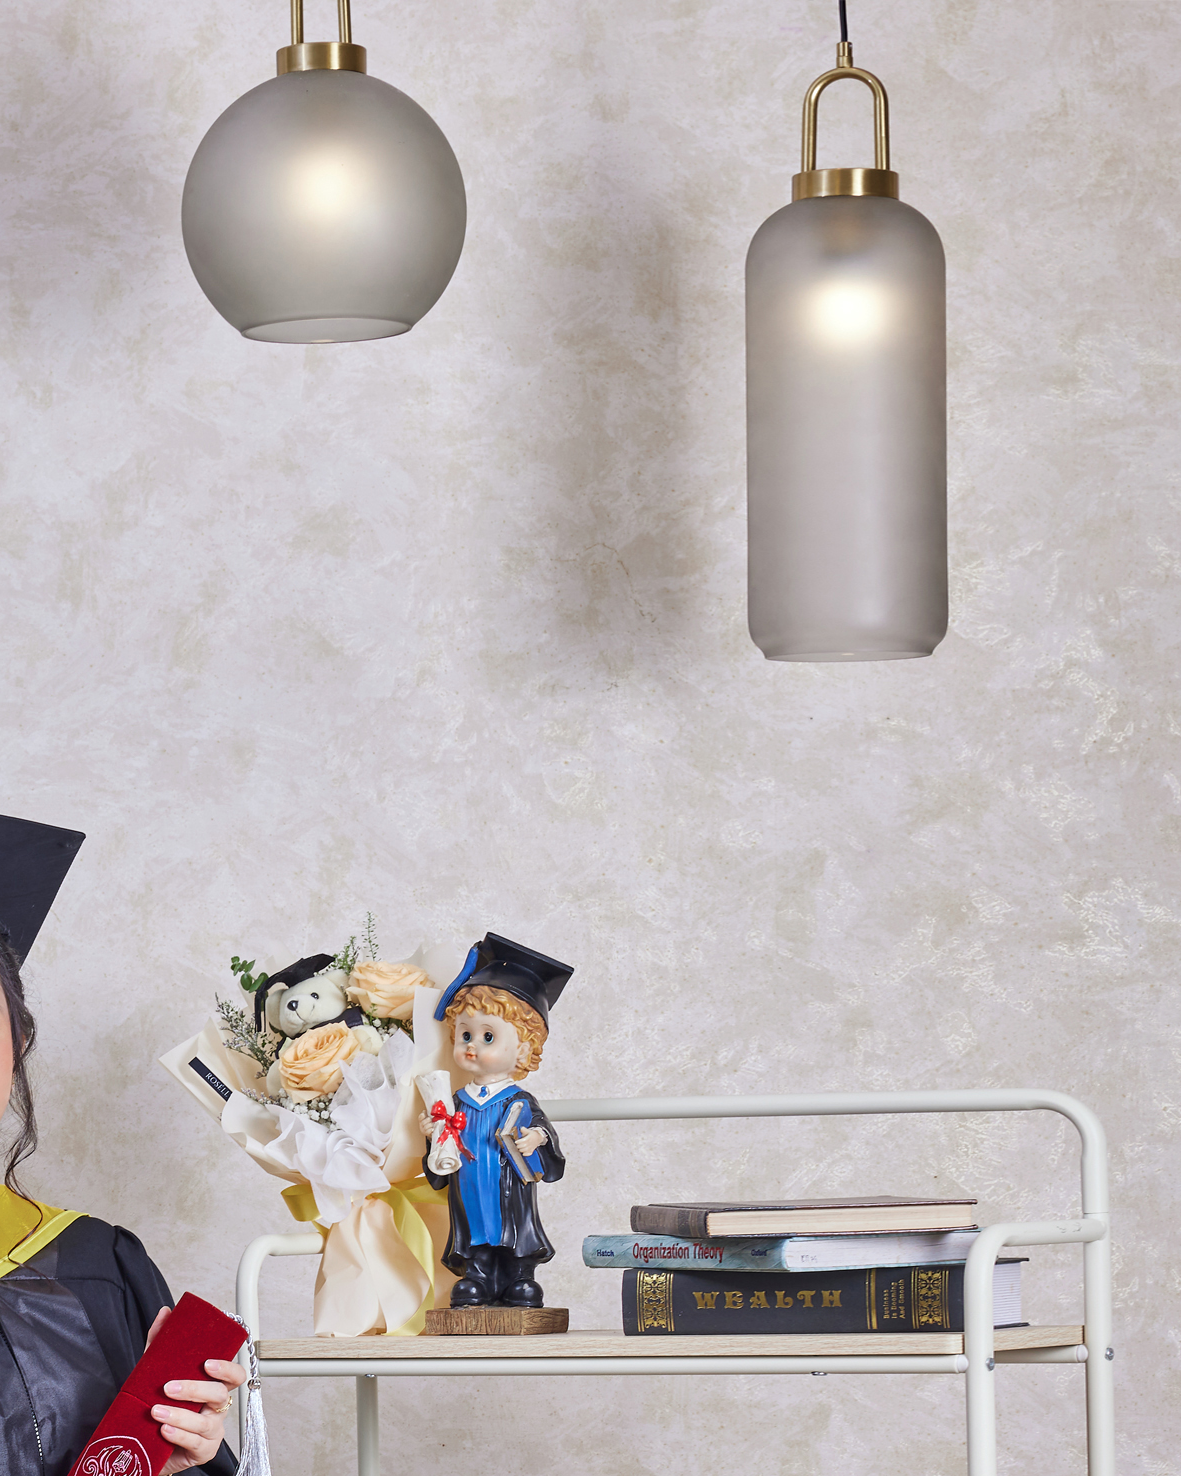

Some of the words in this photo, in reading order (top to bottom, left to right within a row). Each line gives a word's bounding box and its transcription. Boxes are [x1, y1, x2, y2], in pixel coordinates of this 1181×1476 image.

[596, 1249, 615, 1257] Hatch
[632, 1243, 690, 1264] Organization
[693, 1243, 725, 1264] Theory
[692, 1289, 843, 1309] WEALTH
